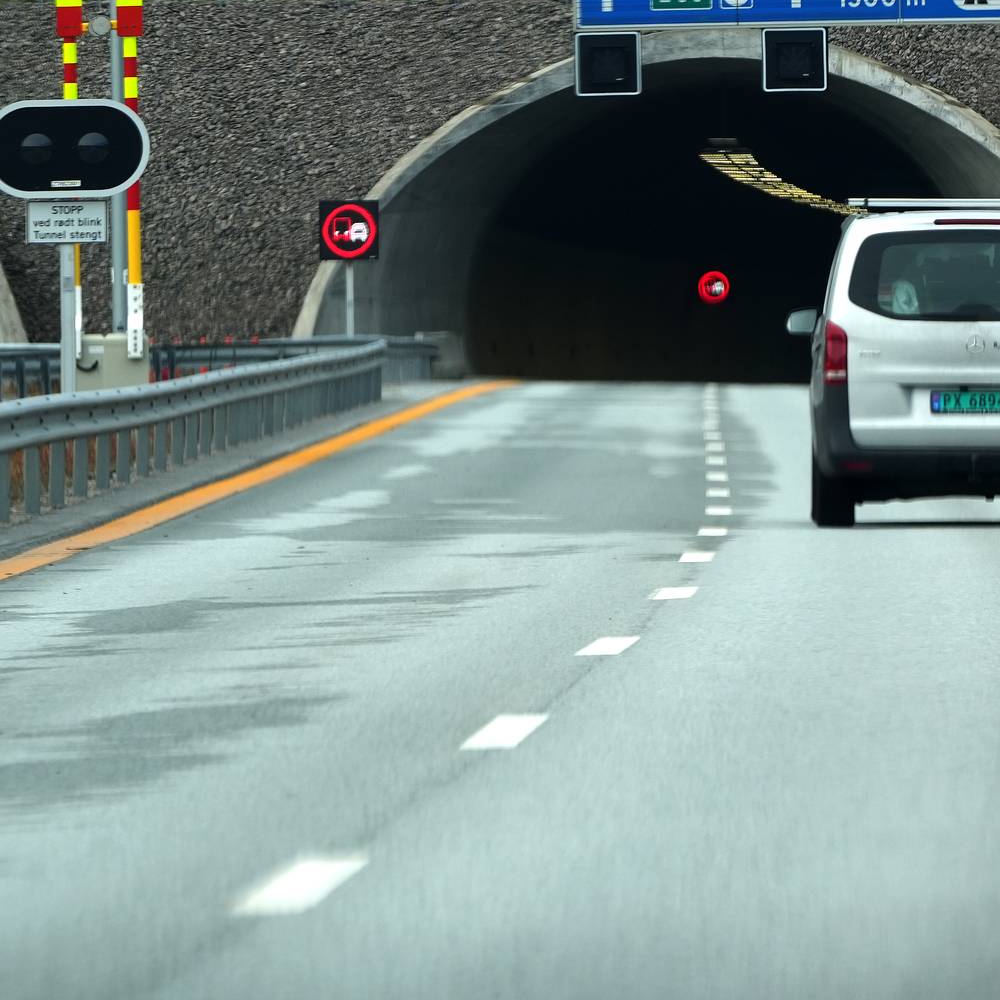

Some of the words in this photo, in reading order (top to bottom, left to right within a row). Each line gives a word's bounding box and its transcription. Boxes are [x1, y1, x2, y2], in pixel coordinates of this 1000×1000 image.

[51, 205, 84, 215] STOPP
[33, 218, 51, 227] ved
[54, 218, 75, 227] rødt
[78, 217, 102, 227] blink
[33, 230, 66, 239] Tunnel
[69, 230, 102, 240] stengt
